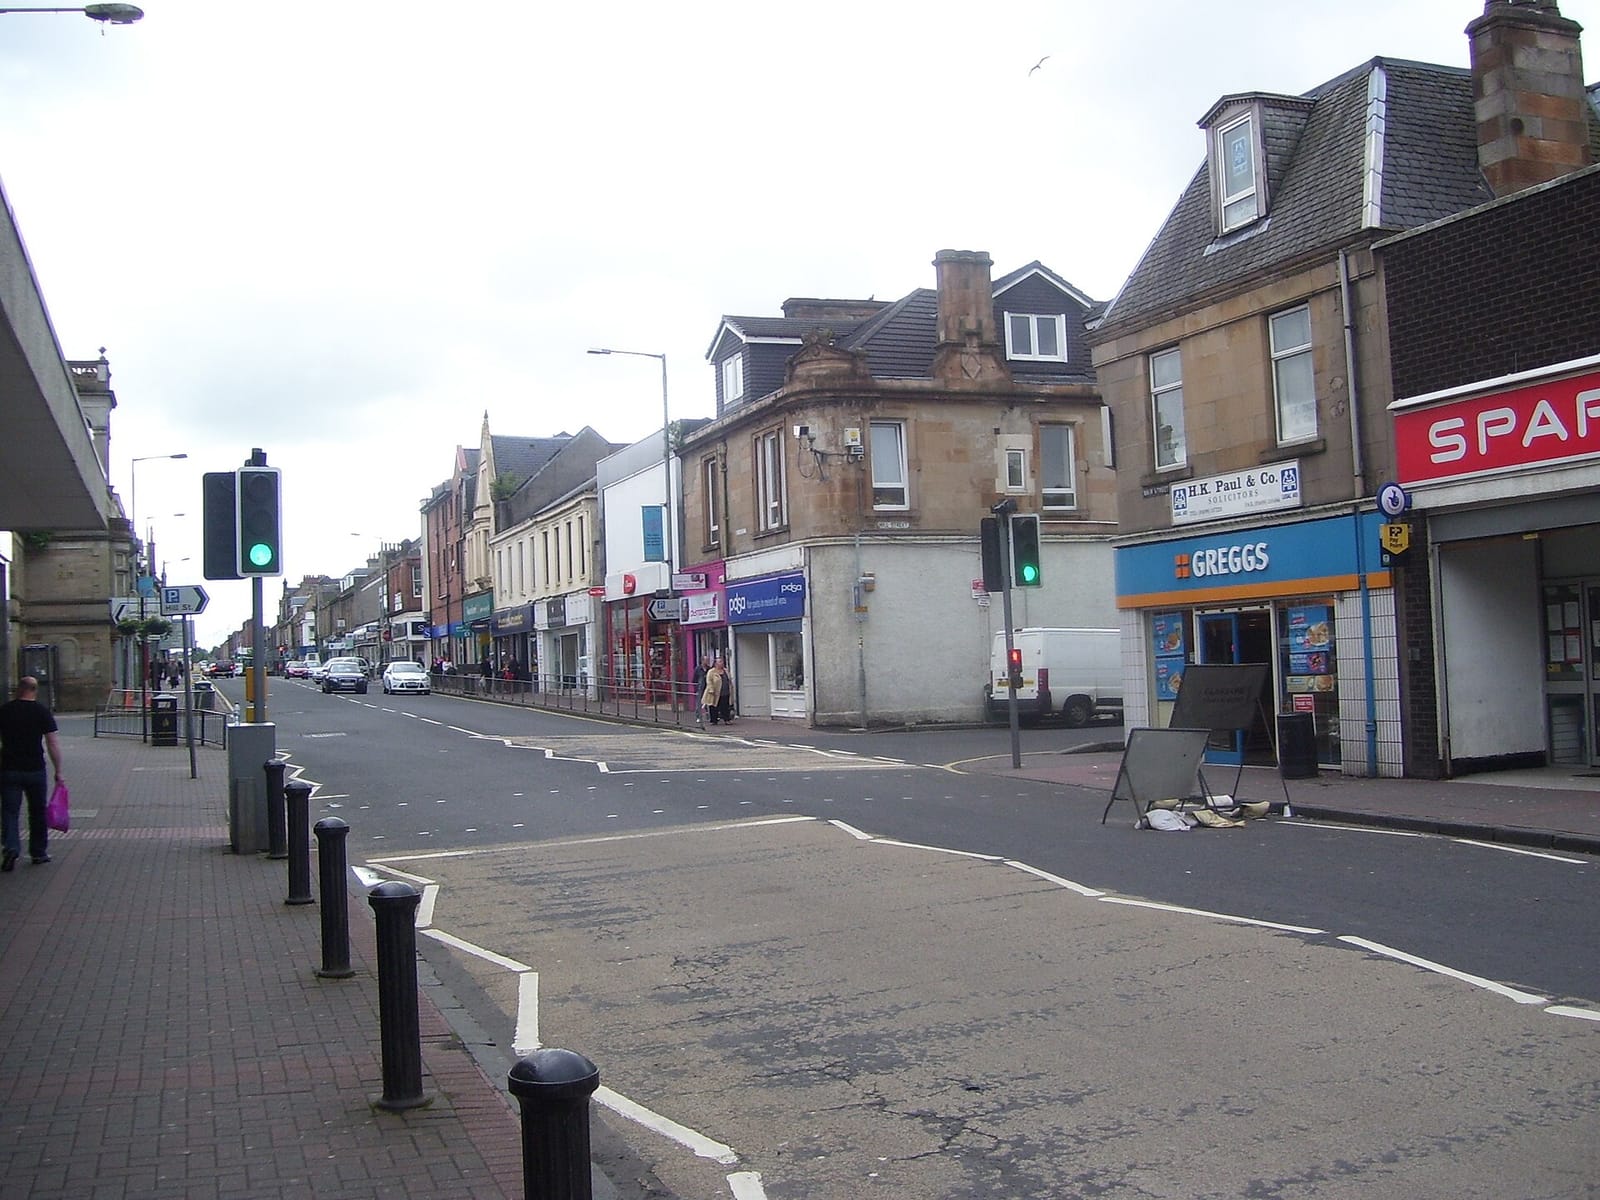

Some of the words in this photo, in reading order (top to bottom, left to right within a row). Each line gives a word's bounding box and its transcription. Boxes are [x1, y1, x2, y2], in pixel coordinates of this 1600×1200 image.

[1188, 482, 1211, 498] H.K.
[1215, 477, 1242, 493] Paul
[1246, 474, 1255, 487] &
[1260, 471, 1279, 485] Co.
[1207, 490, 1259, 505] SOLICITORS
[1192, 542, 1270, 577] GREGGS
[168, 590, 178, 602] P
[781, 582, 802, 593] pdsa
[728, 592, 746, 616] pdsa
